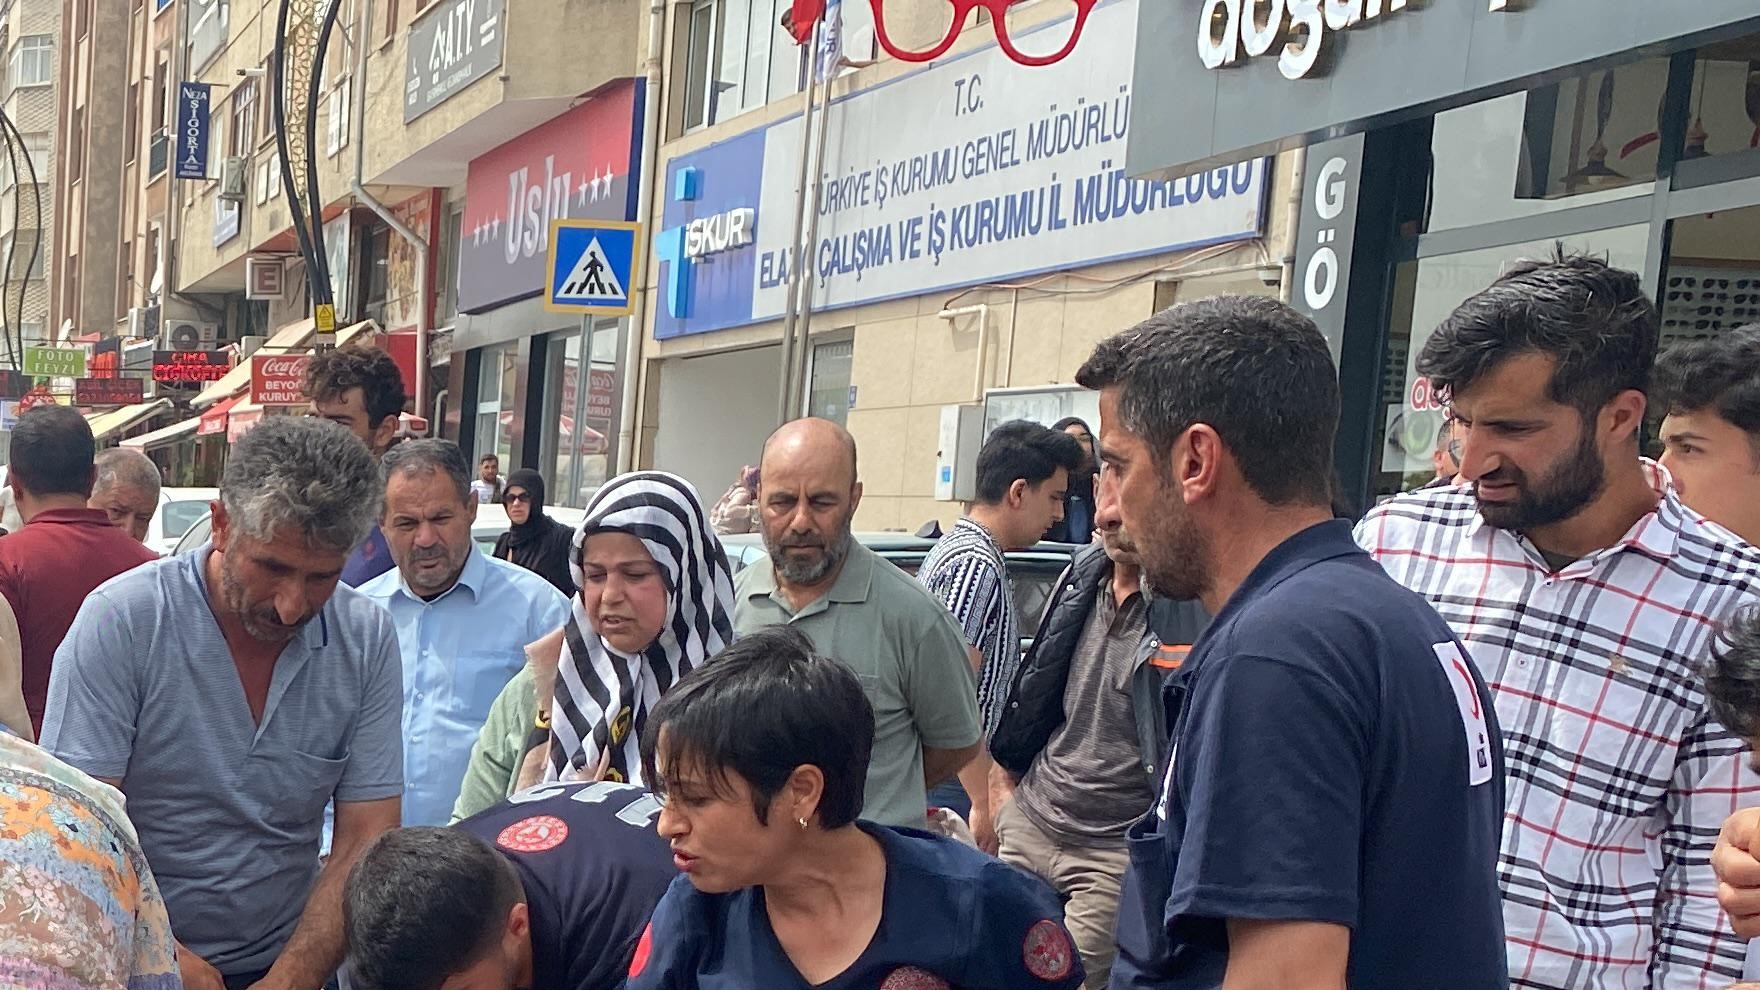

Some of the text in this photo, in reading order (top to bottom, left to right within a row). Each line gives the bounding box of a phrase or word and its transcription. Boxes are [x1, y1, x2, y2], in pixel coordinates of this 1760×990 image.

[813, 84, 1132, 217] ÜRKİYE İŞ KURUMU GENEL MÜDÜRLÜ
[955, 73, 984, 117] T.C.
[504, 154, 572, 265] Uslu
[759, 247, 810, 290] ELA
[818, 223, 894, 289] ÇALIŞMA
[898, 215, 924, 261] VE
[927, 202, 947, 266] İŞ
[949, 187, 1046, 252] KURUMU
[1047, 172, 1067, 232] İL
[37, 350, 74, 362] FOTO
